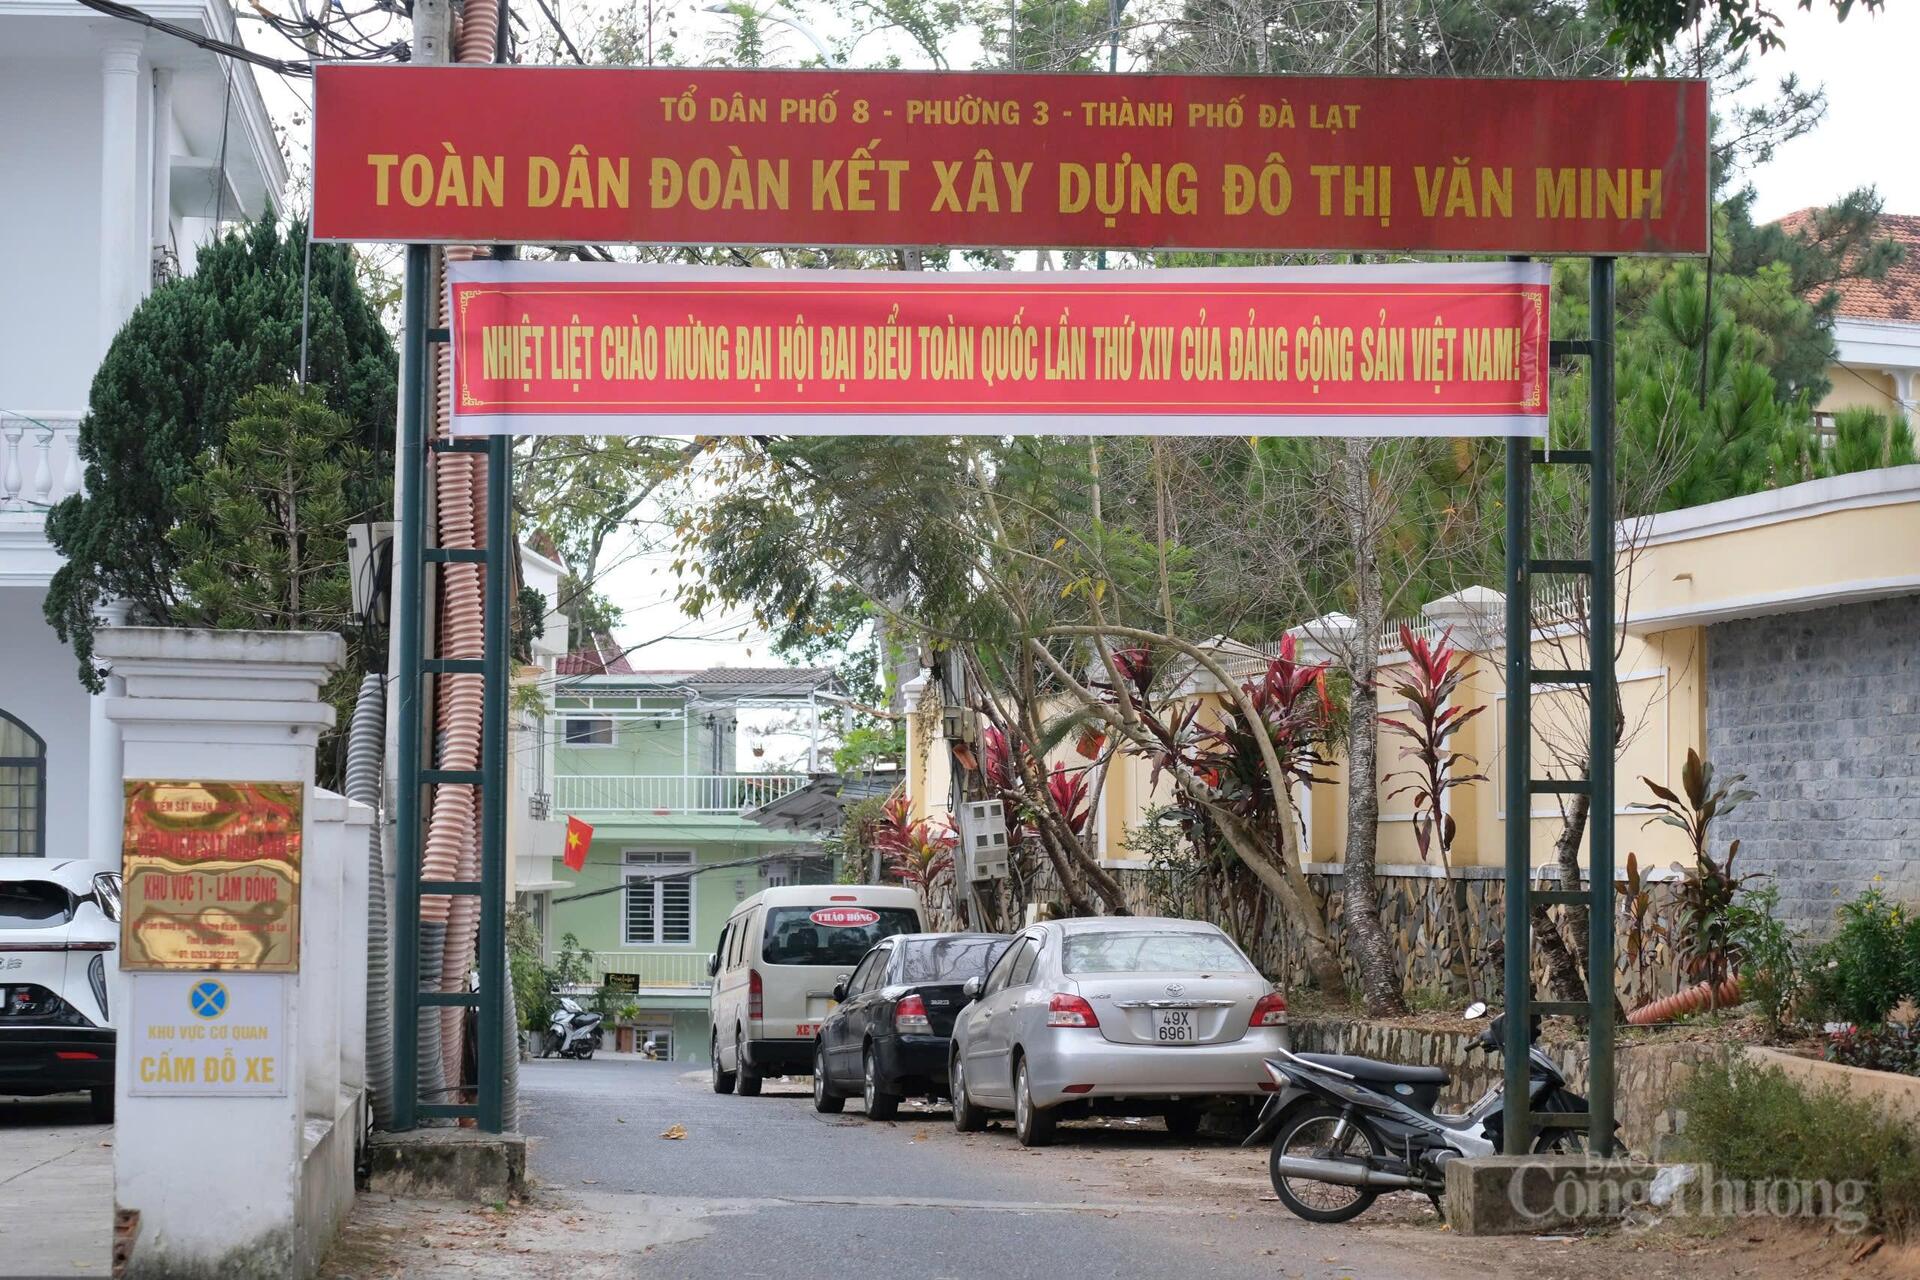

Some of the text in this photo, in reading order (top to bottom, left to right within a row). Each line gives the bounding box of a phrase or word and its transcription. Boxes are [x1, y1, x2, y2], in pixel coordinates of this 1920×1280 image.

[661, 84, 698, 123] TỔ
[709, 91, 767, 123] DÂN
[780, 92, 838, 124] PHỐ
[852, 100, 870, 124] 8
[906, 95, 1020, 126] PHƯỜNG
[1033, 101, 1049, 126] 3
[1082, 96, 1173, 128] THÀNH
[1188, 96, 1245, 129] PHỐ
[1258, 103, 1296, 129] ĐÀ
[1310, 104, 1361, 134] LẠT
[367, 138, 1664, 228] TOÀN DÂN ĐOÀN KẾT XÂY DỰNG ĐÔ THỊ VĂN MINH
[482, 303, 1521, 394] NHIỆT LIỆT CHÀO MỪNG ĐẠI HỘI ĐẠI BIỂU TOÀN QUỐC LẦN THỨ XIV CỦA ĐẢNG CỘNG SẢN VIỆT NAM!
[143, 874, 168, 900] KHU
[171, 873, 195, 906] VỰC
[198, 875, 204, 900] 1
[147, 1025, 176, 1040] KHU
[231, 1025, 269, 1041] QUAN
[796, 1025, 810, 1036] XE
[1158, 1026, 1193, 1041] 6961
[1163, 1011, 1189, 1025] 49X
[140, 1046, 275, 1083] CẤM ĐỖ XE
